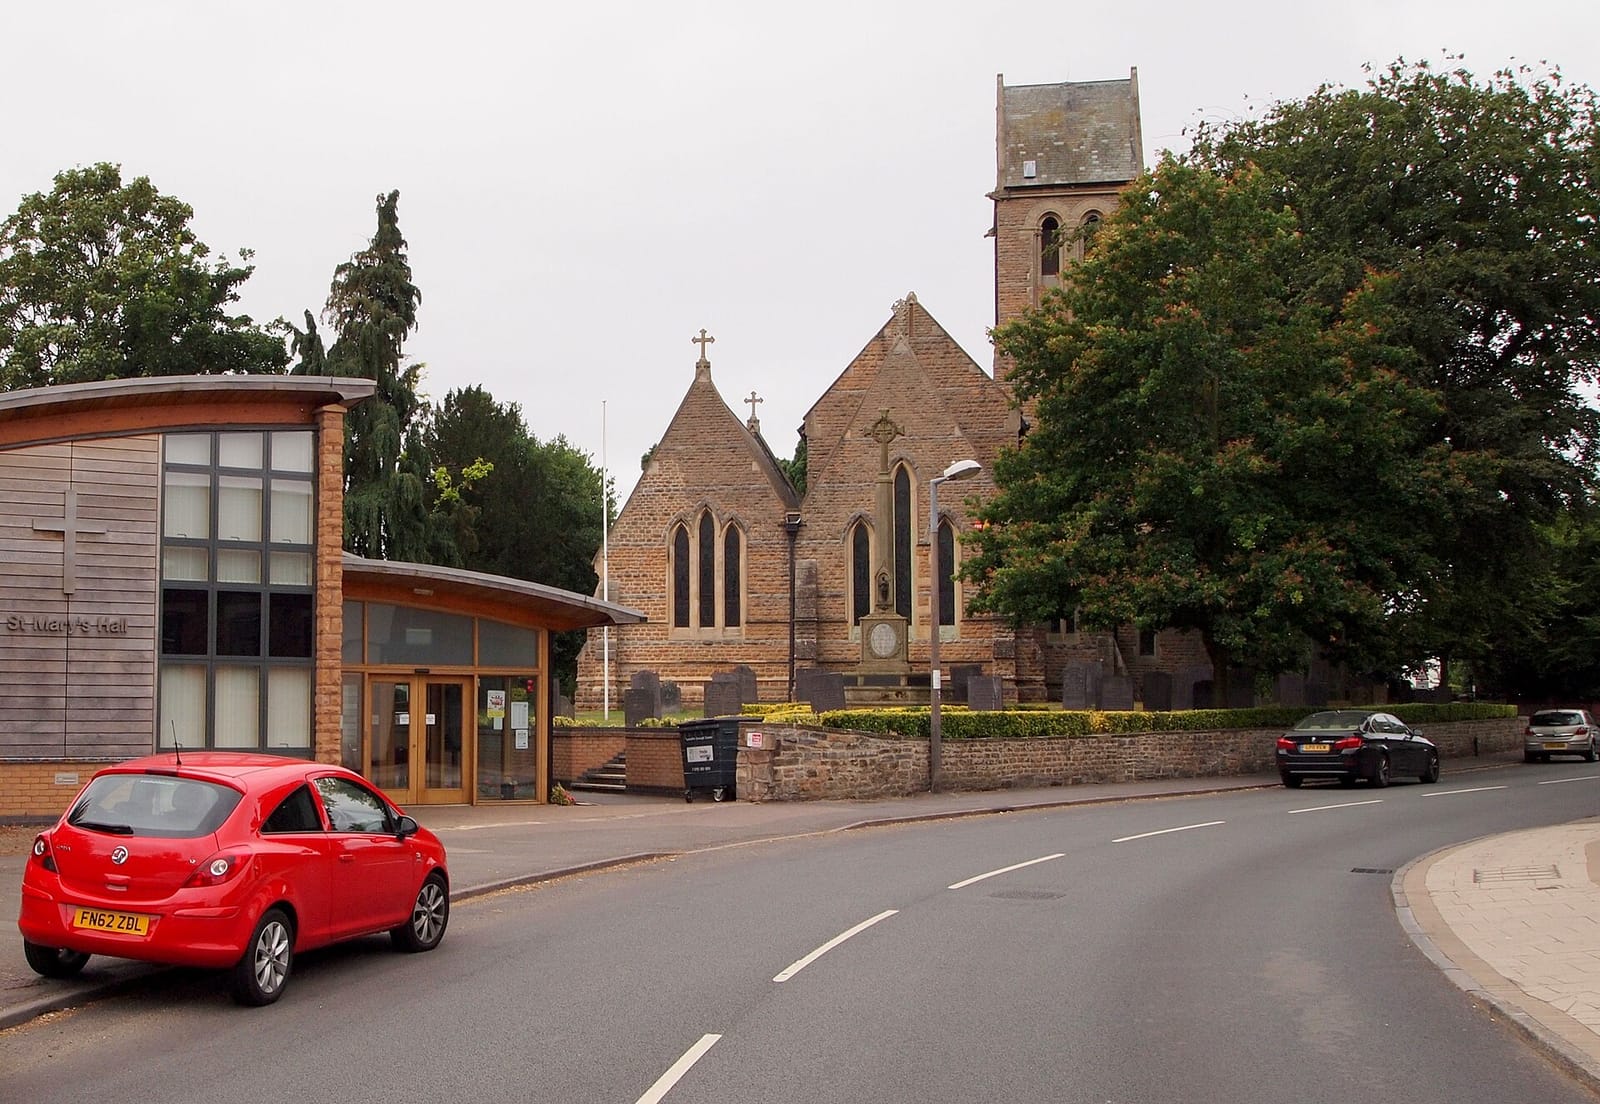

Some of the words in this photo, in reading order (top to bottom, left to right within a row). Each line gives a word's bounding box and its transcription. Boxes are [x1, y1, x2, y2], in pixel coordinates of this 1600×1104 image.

[7, 616, 25, 631] St
[33, 616, 90, 635] Mary's
[97, 618, 128, 634] Hall
[80, 911, 115, 928] FN62
[117, 915, 142, 931] ZDL
